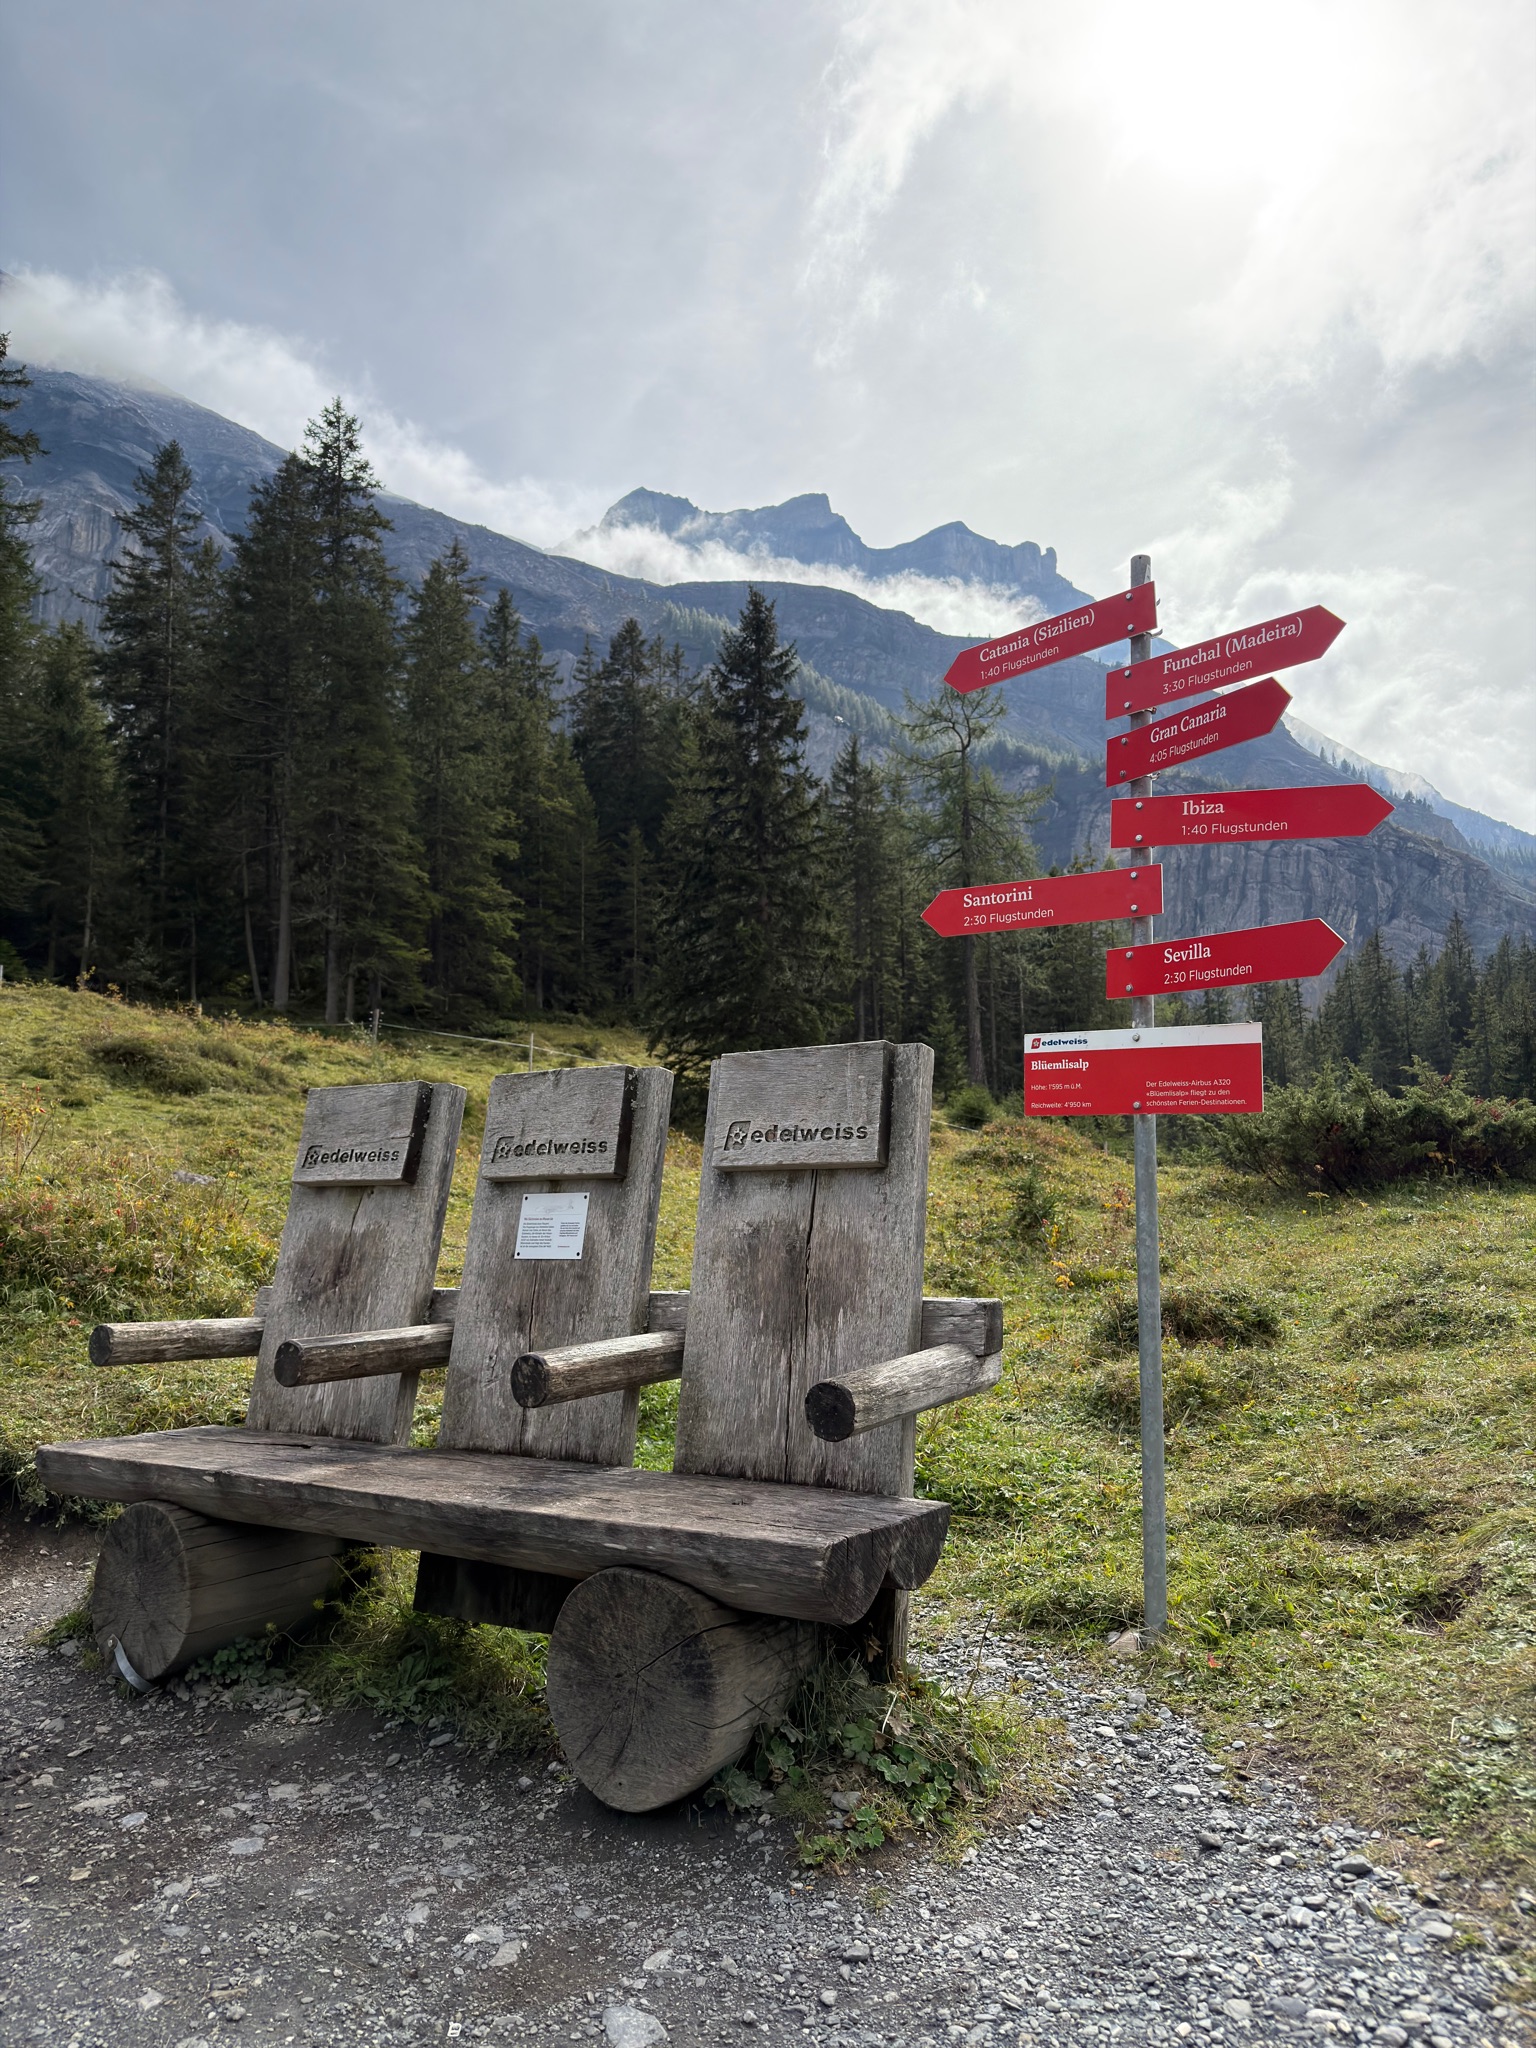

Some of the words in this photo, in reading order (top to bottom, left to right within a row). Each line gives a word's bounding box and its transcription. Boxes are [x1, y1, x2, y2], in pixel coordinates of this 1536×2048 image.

[980, 636, 1030, 662] Catania
[1034, 609, 1095, 646] (Sizilien)
[1163, 642, 1221, 674] Funchal
[1226, 617, 1302, 657] (Madeira)
[980, 666, 1000, 680] 1:40
[1003, 646, 1059, 673] Flugstunden
[1163, 679, 1185, 695] 3:30
[1189, 661, 1252, 686] Flugstunden
[1151, 725, 1177, 742] Gran
[1181, 705, 1226, 731] Canaria
[1149, 749, 1168, 763] 4:05
[1170, 733, 1218, 756] Flugstunden
[1183, 800, 1224, 815] Ibiza
[1182, 824, 1207, 835] 1:40
[1212, 821, 1287, 834] Flugstunden
[964, 886, 1032, 907] Santorini
[964, 915, 986, 926] 2:30
[990, 908, 1053, 923] Flugstunden
[1164, 943, 1211, 963] Sevilla
[1165, 972, 1186, 984] 2:30
[1190, 965, 1252, 981] Flugstunden
[1041, 1038, 1088, 1046] edelweiss
[1031, 1058, 1089, 1071] Blüemlisalp
[1158, 1079, 1212, 1087] Edelweiss-Airbus
[1213, 1078, 1231, 1086] A320
[1146, 1099, 1178, 1107] schönsten
[1178, 1098, 1247, 1106] Ferien-Destinationen.
[750, 1122, 869, 1143] edelweiss
[321, 1147, 400, 1164] edelweiss
[513, 1138, 608, 1157] edelweiss
